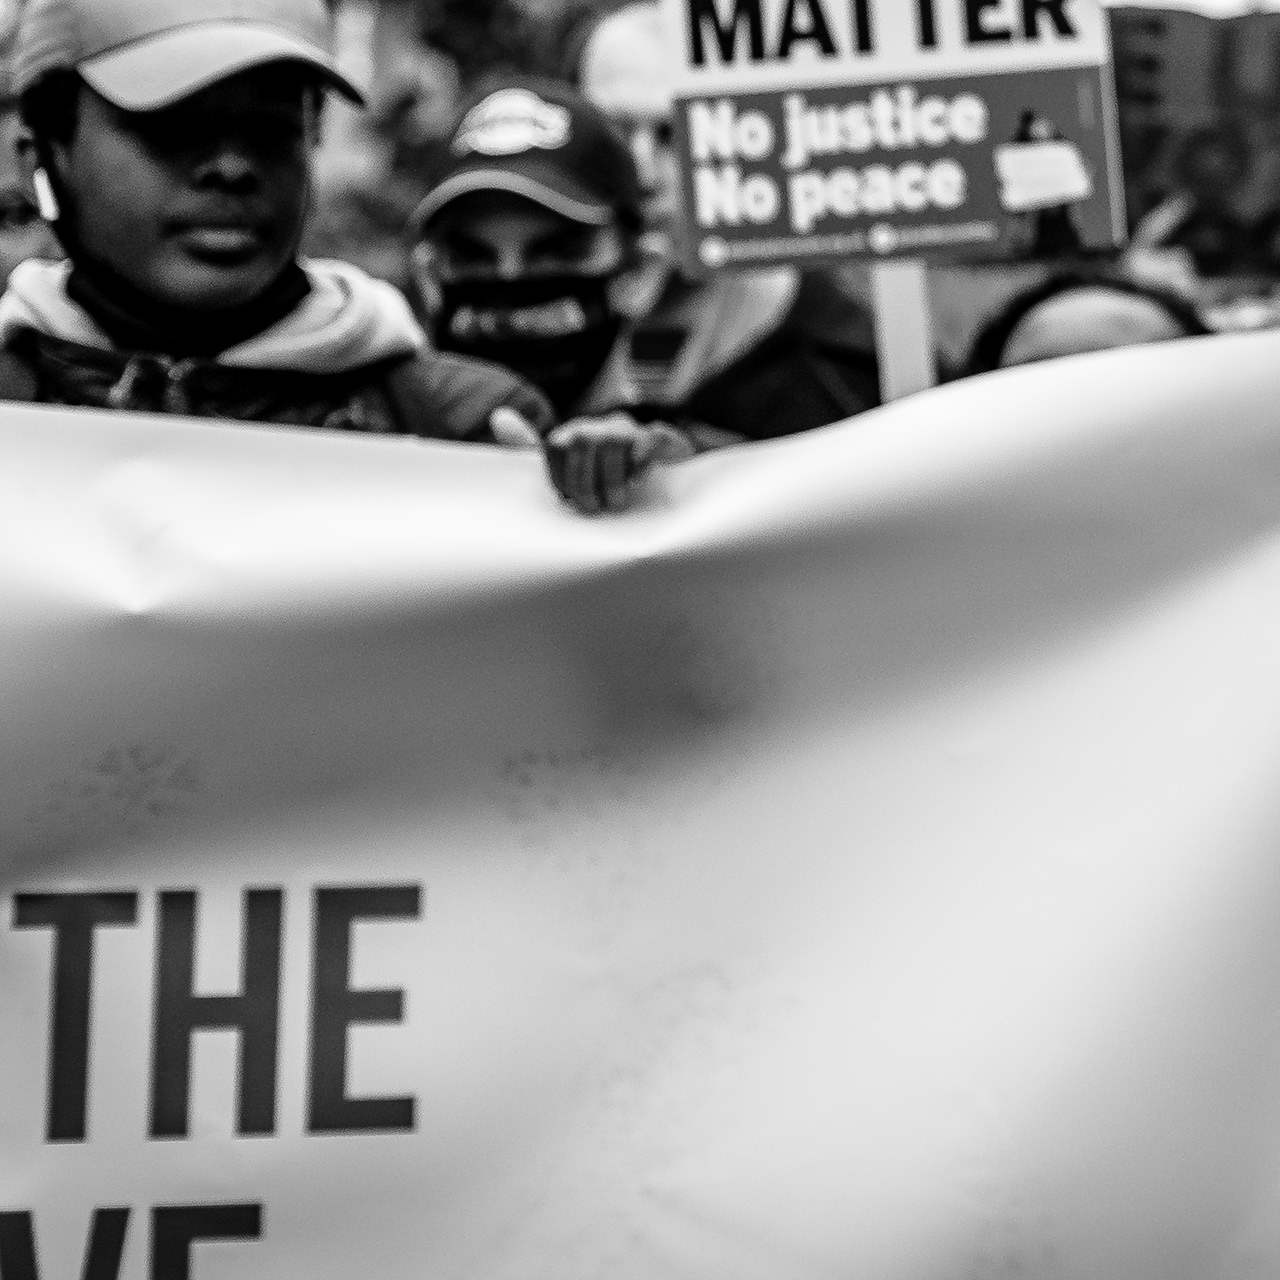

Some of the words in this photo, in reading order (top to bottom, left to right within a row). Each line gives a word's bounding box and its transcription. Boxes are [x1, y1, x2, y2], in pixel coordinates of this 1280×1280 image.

[690, 101, 772, 160] No
[783, 85, 988, 167] justice
[698, 166, 778, 227] No
[789, 160, 966, 232] peace
[15, 885, 421, 1143] THE
